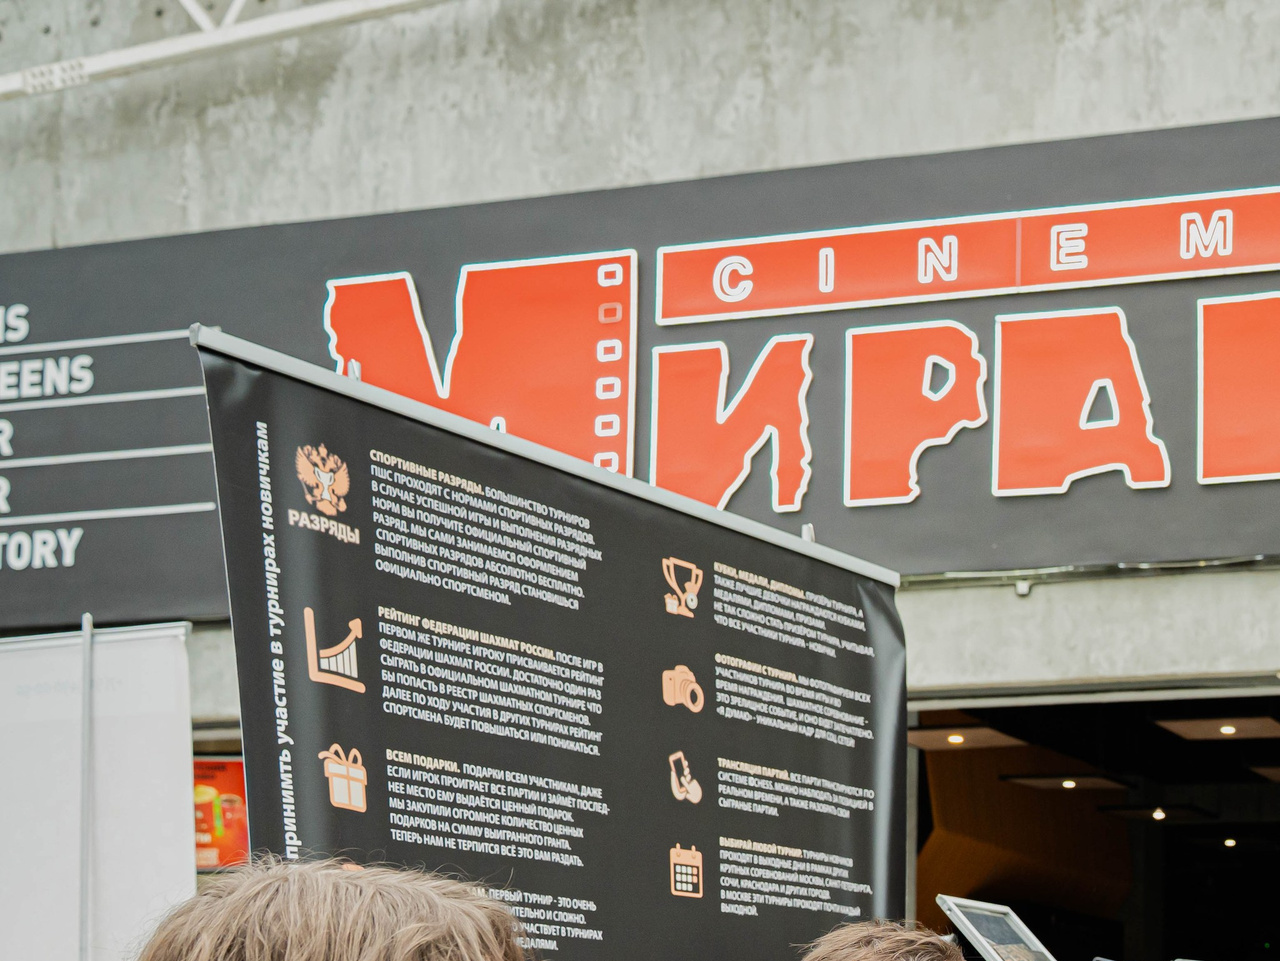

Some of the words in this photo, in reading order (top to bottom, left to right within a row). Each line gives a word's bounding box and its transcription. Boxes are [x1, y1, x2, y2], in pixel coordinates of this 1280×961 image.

[255, 421, 276, 531] новичкам
[369, 449, 437, 480] СПОРТИВНЫЕ
[438, 471, 484, 495] РАЗРЯДЫ.
[485, 486, 548, 515] БОЛЬШИНСТВО
[548, 506, 590, 529] ТУРНИРОВ
[287, 509, 361, 544] РАЗРЯДЫ
[370, 464, 392, 481] ПШС
[394, 472, 442, 496] ПРОХОДЯТ
[451, 490, 497, 513] НОРМАМИ
[498, 505, 553, 531] СПОРТИВНЫХ
[553, 523, 595, 544] РАЗРЯДОВ.
[379, 483, 415, 503] СЛУЧАЕ
[416, 494, 467, 519] УСПЕШНОЙ
[468, 510, 491, 526] ИГРЫ
[500, 520, 556, 546] ВЫПОЛНЕНИЯ
[556, 538, 602, 560] РАЗРЯДНЫХ
[372, 496, 400, 514] НОРМ
[401, 504, 415, 518] ВЫ
[416, 509, 463, 533] ПОЛУЧИТЕ
[464, 524, 532, 552] ОФИЦИАЛЬНЫЙ
[533, 545, 586, 570] СПОРТИВНЫЙ
[264, 530, 285, 637] турнирах
[375, 559, 441, 586] ОФИЦИАЛЬНО
[442, 578, 511, 605] СПОРТСМЕНОМ.
[376, 528, 438, 555] СПОРТИВНЫХ
[439, 546, 484, 568] РАЗРЯДОВ
[484, 560, 537, 583] АБСОЛЮТНО
[538, 574, 584, 598] БЕСПЛАТНО.
[269, 637, 284, 655] в
[378, 606, 420, 626] РЕЙТИНГ
[421, 618, 479, 641] ФЕДЕРАЦИИ
[479, 632, 519, 650] ШАХМАТ
[520, 641, 555, 660] РОССИИ.
[555, 651, 582, 667] ПОСЛЕ
[582, 658, 597, 670] ИГР
[378, 621, 416, 641] ПЕРВОМ
[417, 631, 431, 645] ЖЕ
[431, 635, 471, 654] ТУРНИРЕ
[472, 645, 505, 662] ИГРОКУ
[506, 653, 570, 678] ПРИСВАИВАЕТСЯ
[570, 669, 604, 686] РЕЙТИНГ
[379, 638, 433, 660] ФЕДЕРАЦИИ
[434, 651, 473, 669] ШАХМАТ
[474, 660, 512, 678] РОССИИ.
[512, 669, 563, 691] ДОСТАТОЧНО
[563, 682, 587, 696] ОДИН
[587, 687, 602, 700] РАЗ
[270, 654, 296, 746] участие
[381, 669, 395, 682] БЫ
[396, 672, 438, 692] ПОПАСТЬ
[446, 684, 478, 700] РЕЕСТР
[479, 692, 533, 712] ШАХМАТНЫХ
[534, 703, 590, 725] СПОРТСМЕНОВ.
[383, 701, 443, 723] СПОРТСМЕНА
[443, 714, 470, 729] БУДЕТ
[471, 719, 529, 740] ПОВЫШАТЬСЯ
[530, 731, 547, 744] ИЛИ
[547, 735, 600, 756] ПОНИЖАТЬСЯ.
[386, 748, 412, 764] ВСЕМ
[413, 754, 460, 772] ПОДАРКИ.
[462, 763, 504, 780] ПОДАРКИ
[505, 770, 528, 784] ВСЕМ
[528, 775, 580, 795] УЧАСТНИКАМ,
[580, 785, 602, 798] ДАЖЕ
[388, 781, 405, 794] НЕЕ
[406, 784, 436, 799] МЕСТО
[436, 789, 455, 802] ЕМУ
[455, 792, 500, 809] ВЫДАЁТСЯ
[501, 800, 537, 815] ЦЕННЫЙ
[537, 805, 574, 822] ПОДАРОК.
[388, 796, 405, 809] МЫ
[406, 799, 451, 817] ЗАКУПИЛИ
[452, 807, 500, 824] ОГРОМНОЕ
[501, 815, 553, 832] КОЛИЧЕСТВО
[553, 823, 583, 838] ЦЕННЫХ
[390, 812, 437, 830] ПОДАРКОВ
[437, 820, 451, 832] НА
[451, 822, 483, 837] СУММУ
[484, 827, 543, 845] ВЫИГРАННОГО
[543, 836, 571, 850] ГРАНТА.
[390, 828, 422, 844] ТЕПЕРЬ
[423, 834, 444, 847] НАМ
[444, 837, 456, 849] НЕ
[457, 838, 500, 854] ТЕРПИТСЯ
[500, 844, 516, 857] ВСЁ
[517, 846, 533, 859] ЭТО
[533, 849, 551, 861] ВАМ
[551, 852, 584, 866] РАЗДАТЬ.
[489, 889, 522, 902] ПЕРВЫЙ
[524, 892, 553, 905] ТУРНИР
[558, 897, 571, 908] ЭТО
[572, 900, 596, 911] ОЧЕНЬ
[553, 912, 586, 924] СЛОЖНО.
[567, 928, 603, 940] ТУРНИРАХ
